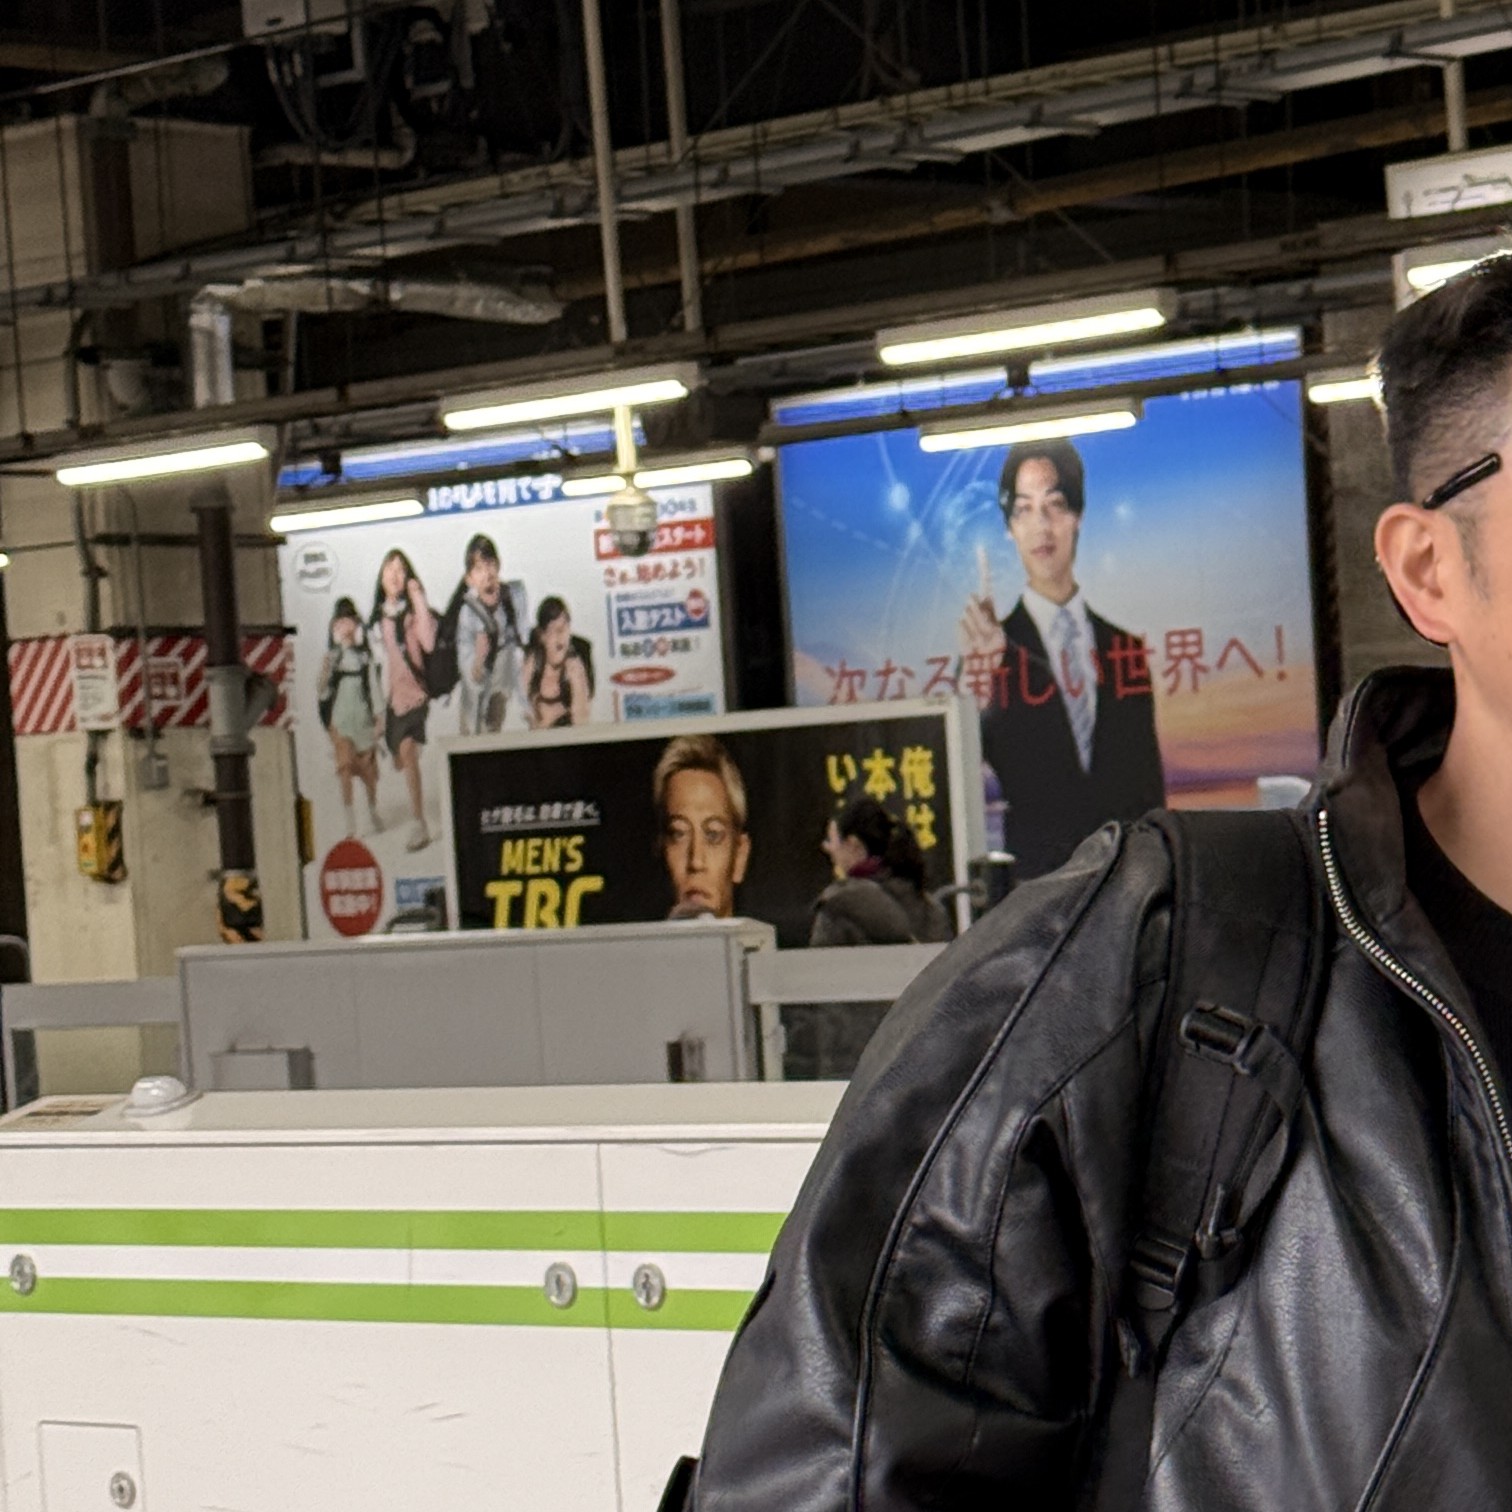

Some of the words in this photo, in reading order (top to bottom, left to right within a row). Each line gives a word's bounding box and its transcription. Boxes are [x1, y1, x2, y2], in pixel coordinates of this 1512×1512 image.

[824, 624, 1288, 707] 次なる新しい世界へ!
[501, 834, 586, 876] MEN'S
